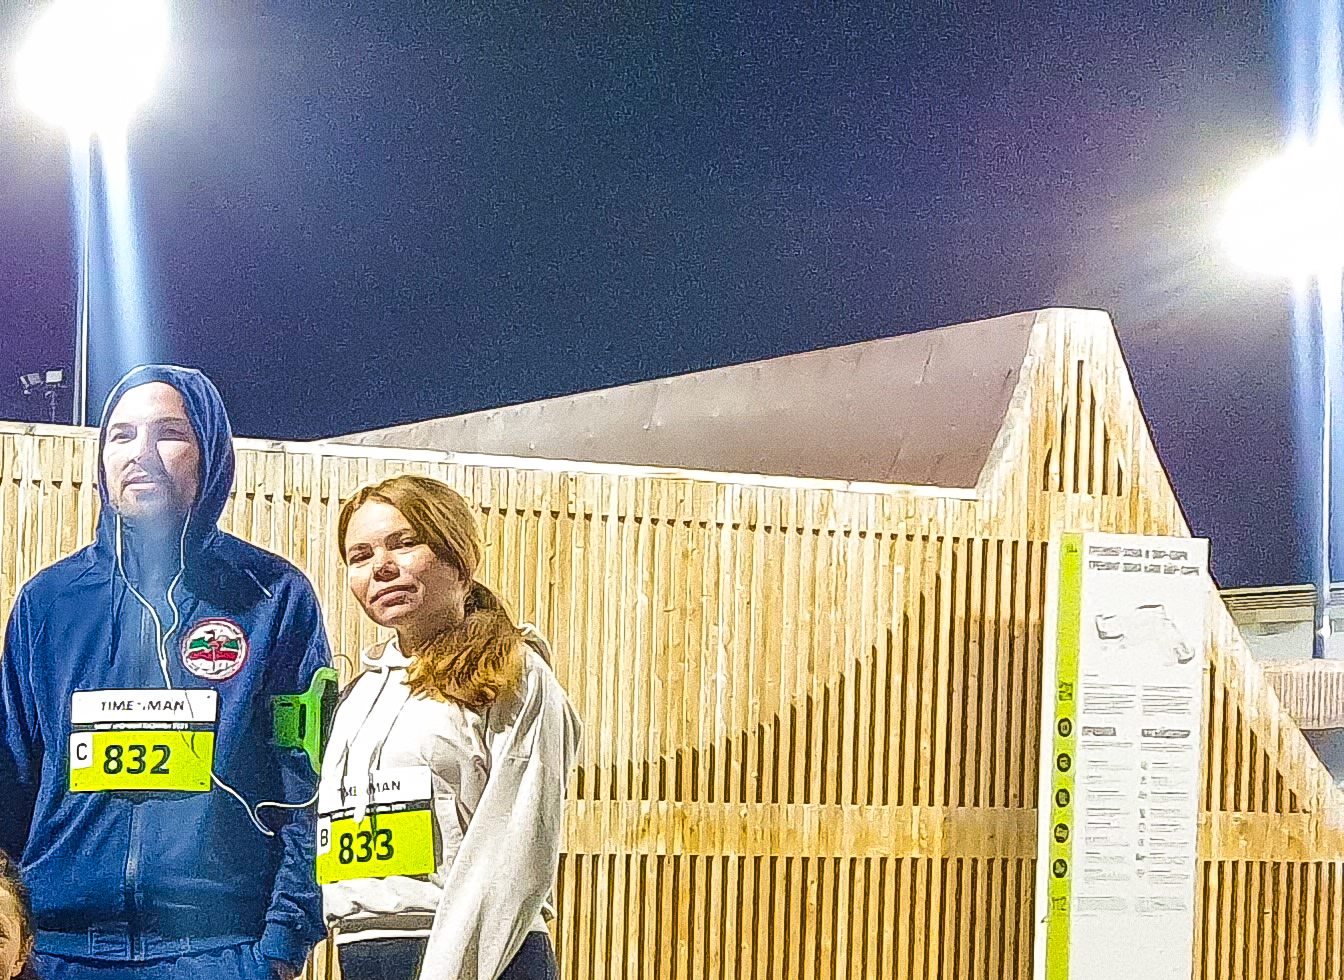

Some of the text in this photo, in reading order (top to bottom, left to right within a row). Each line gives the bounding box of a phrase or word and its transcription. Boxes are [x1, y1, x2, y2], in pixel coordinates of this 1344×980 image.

[76, 742, 88, 761] C
[103, 744, 172, 775] 832
[338, 828, 395, 865] 833
